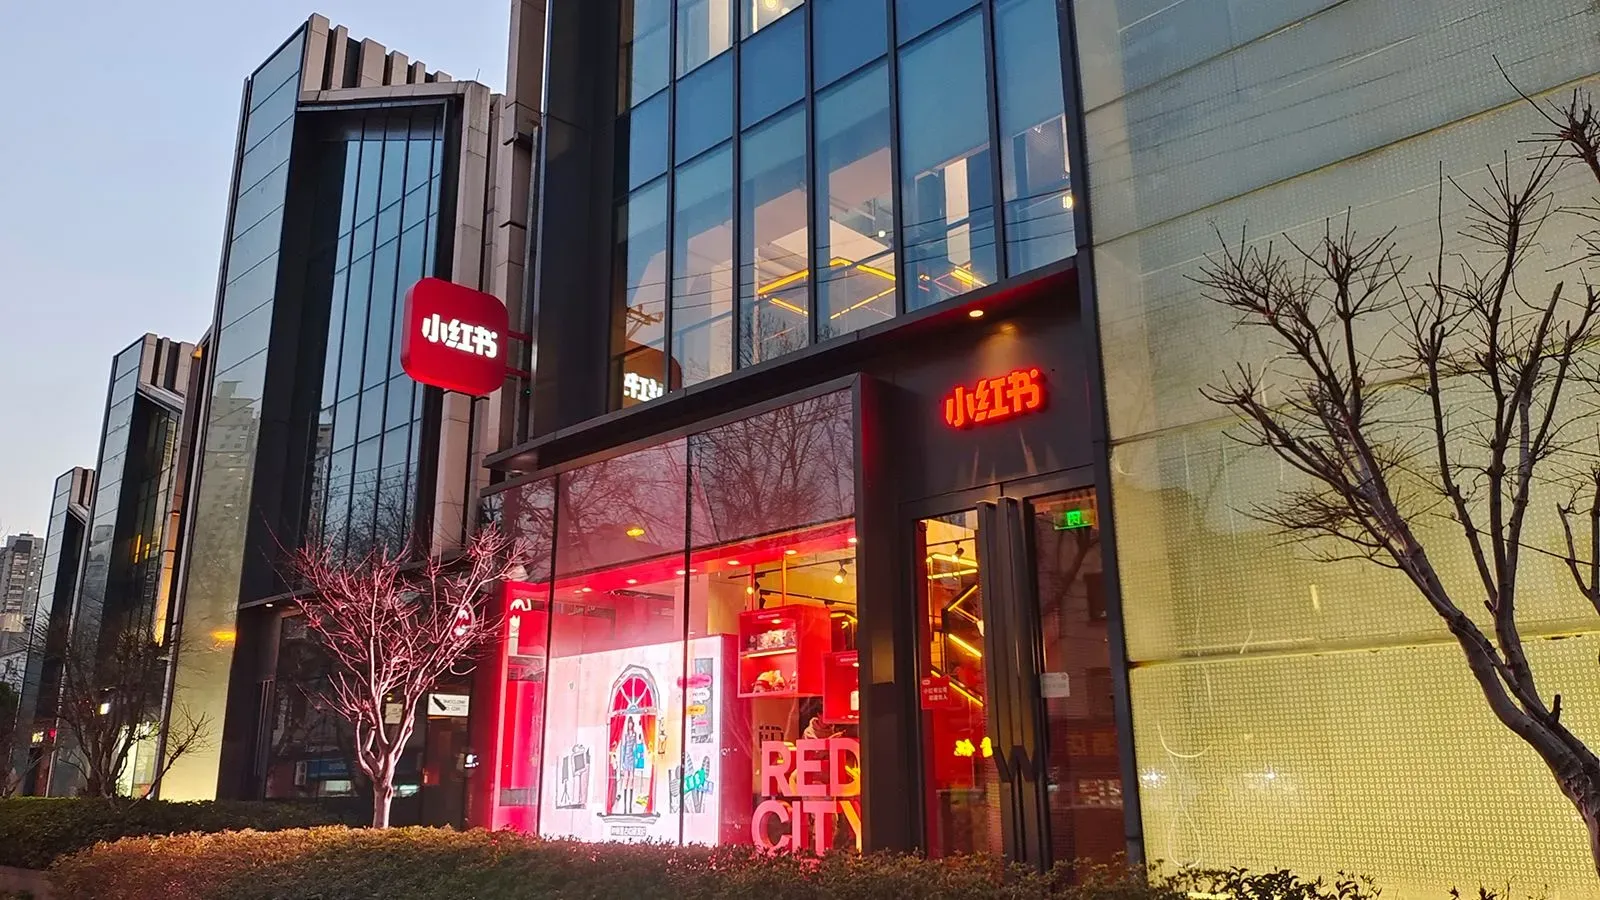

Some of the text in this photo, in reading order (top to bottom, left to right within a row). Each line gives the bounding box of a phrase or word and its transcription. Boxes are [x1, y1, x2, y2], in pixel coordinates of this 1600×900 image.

[421, 313, 498, 358] 小红书
[946, 368, 1039, 427] 小红书
[761, 738, 860, 797] RED
